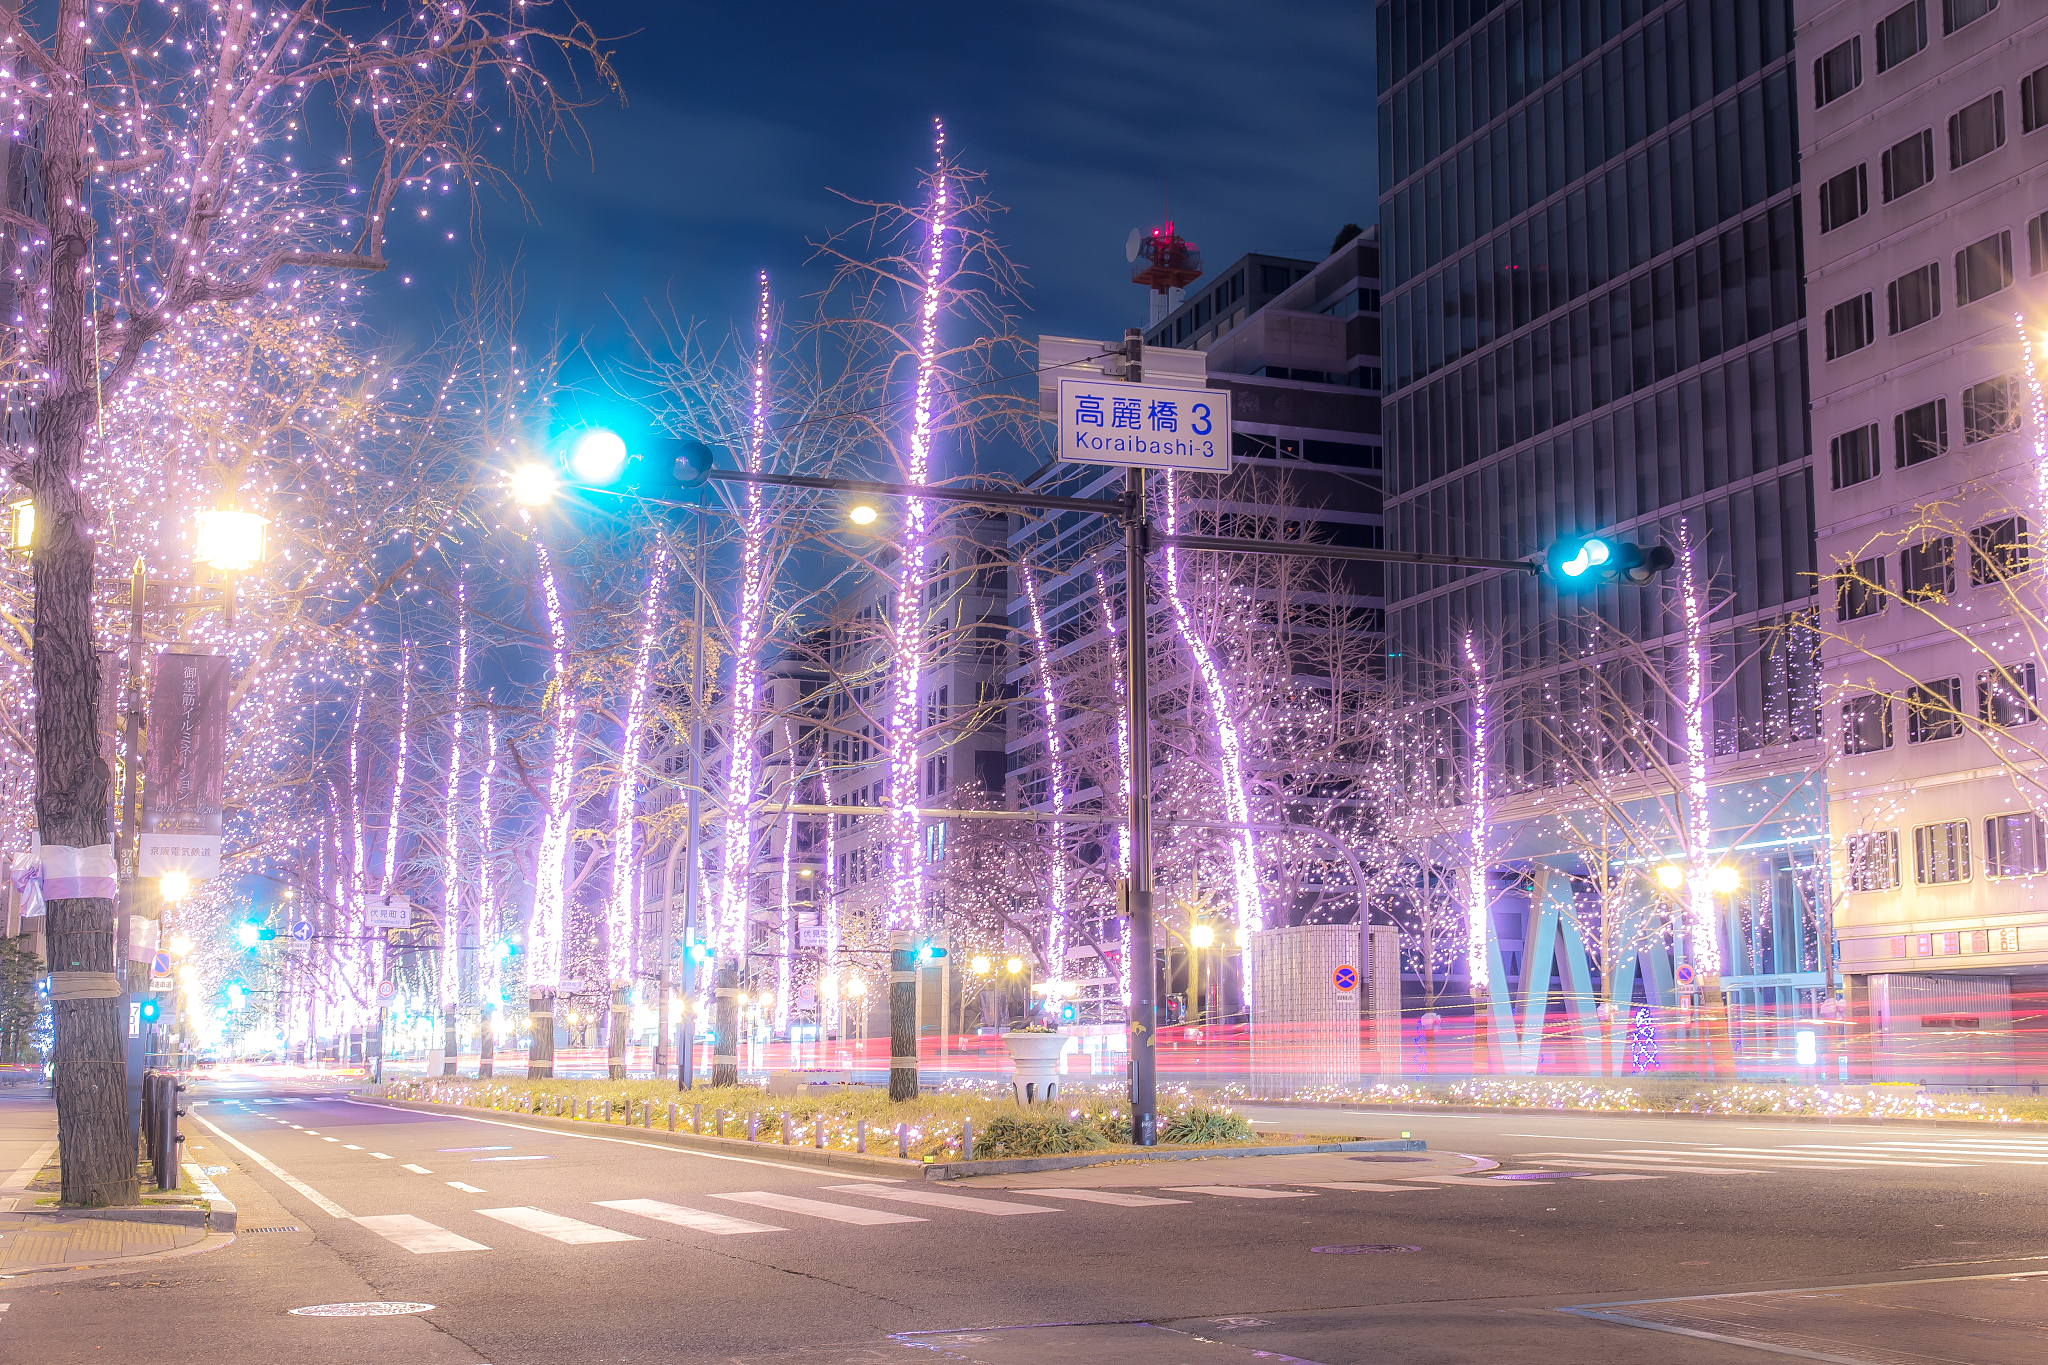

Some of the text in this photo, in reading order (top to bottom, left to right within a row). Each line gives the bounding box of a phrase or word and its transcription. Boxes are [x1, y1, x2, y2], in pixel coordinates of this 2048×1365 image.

[1074, 394, 1212, 436] 高麗橋 3
[1076, 431, 1214, 458] Koraibashi-3
[178, 666, 197, 802] 御堂筋イルミネーション
[121, 849, 133, 858] 37
[150, 846, 211, 857] 京阪電気鉄道
[370, 909, 406, 919] 伏見町 3
[1890, 929, 2017, 957] 朝日生命館
